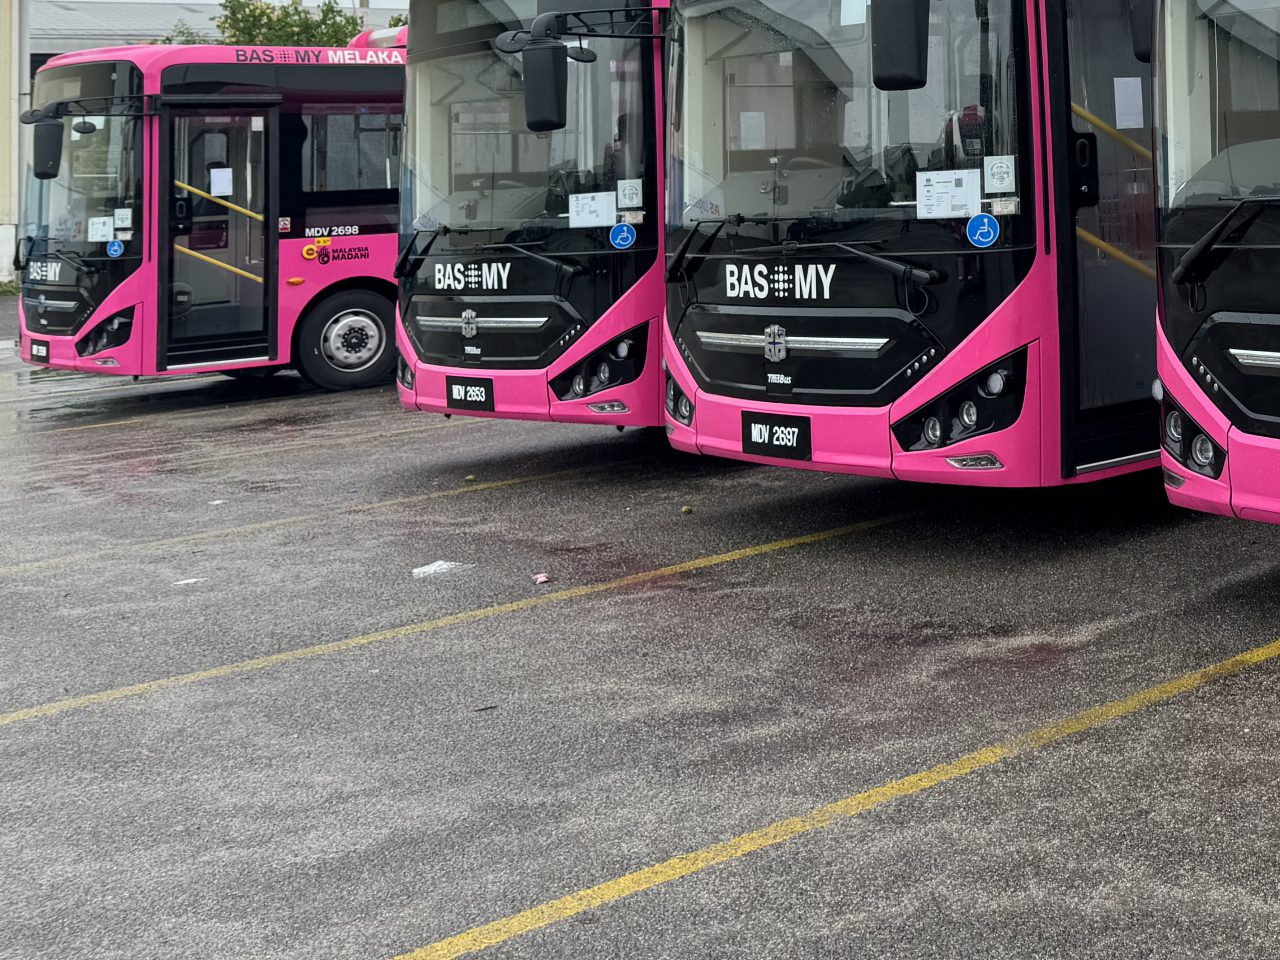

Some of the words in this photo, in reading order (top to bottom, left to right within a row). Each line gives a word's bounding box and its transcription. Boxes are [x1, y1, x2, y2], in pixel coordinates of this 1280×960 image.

[235, 49, 275, 63] BAS
[295, 50, 322, 63] MY
[327, 50, 403, 64] MELAKA
[305, 227, 330, 237] MDV
[331, 225, 360, 236] 2698
[332, 246, 369, 254] MALAYSIA
[332, 252, 369, 261] MADANI
[47, 262, 62, 281] MY
[434, 262, 465, 290] BAS
[481, 262, 511, 290] MY
[725, 263, 769, 299] BAS
[794, 264, 836, 300] MY
[466, 386, 486, 402] 2653
[751, 422, 769, 444] MDV
[772, 425, 799, 447] 2697
